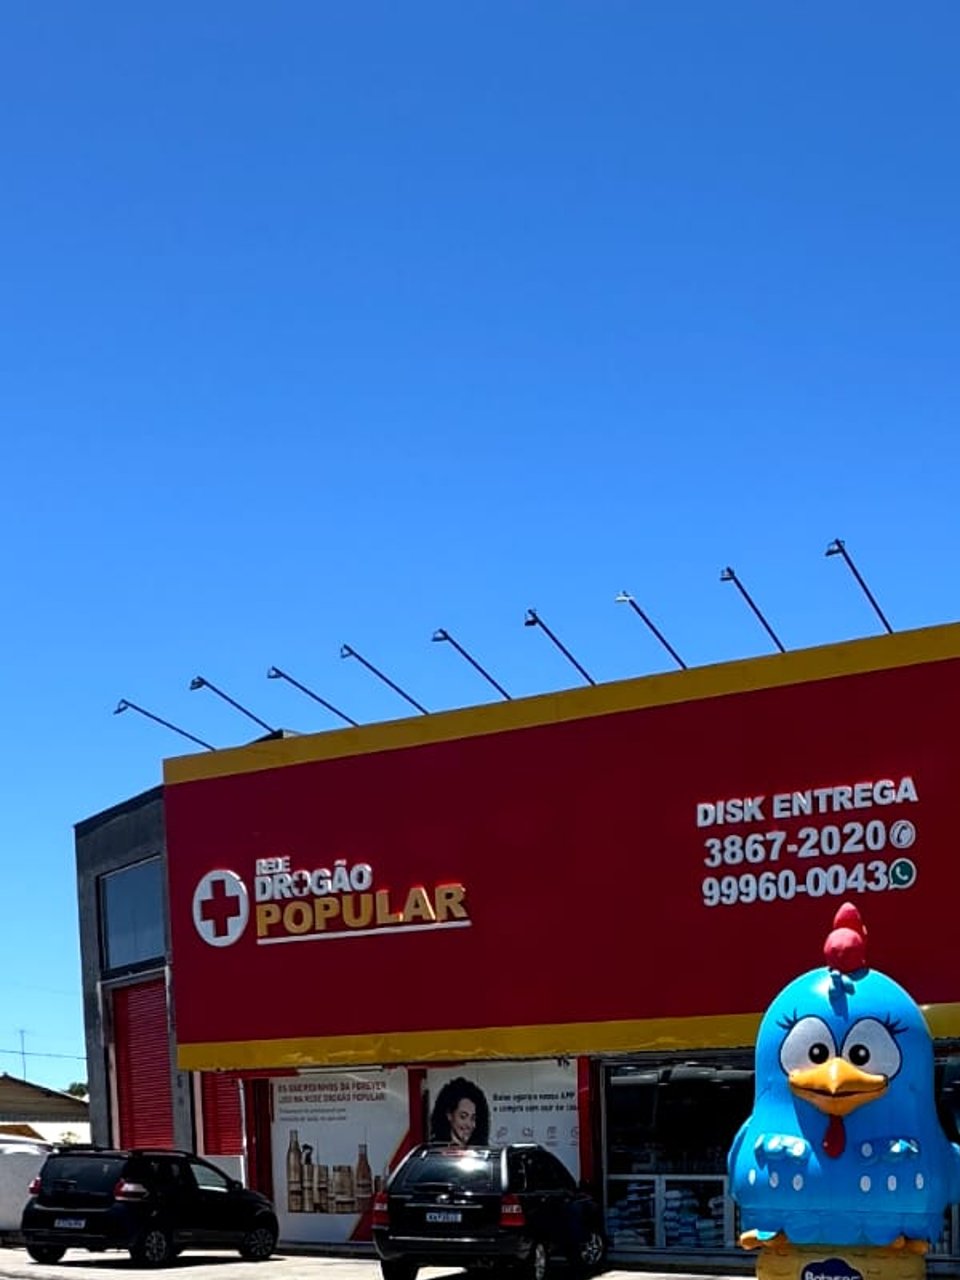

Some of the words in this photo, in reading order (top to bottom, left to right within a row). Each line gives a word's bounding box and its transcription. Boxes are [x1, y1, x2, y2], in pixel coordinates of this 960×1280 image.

[696, 796, 765, 828] DISK
[772, 776, 919, 819] ENTREGA
[255, 856, 291, 876] REDE
[703, 819, 886, 868] 3867-2020
[255, 858, 373, 902] DROGÃO
[701, 859, 888, 907] 99960-0043
[256, 882, 469, 937] POPULAR
